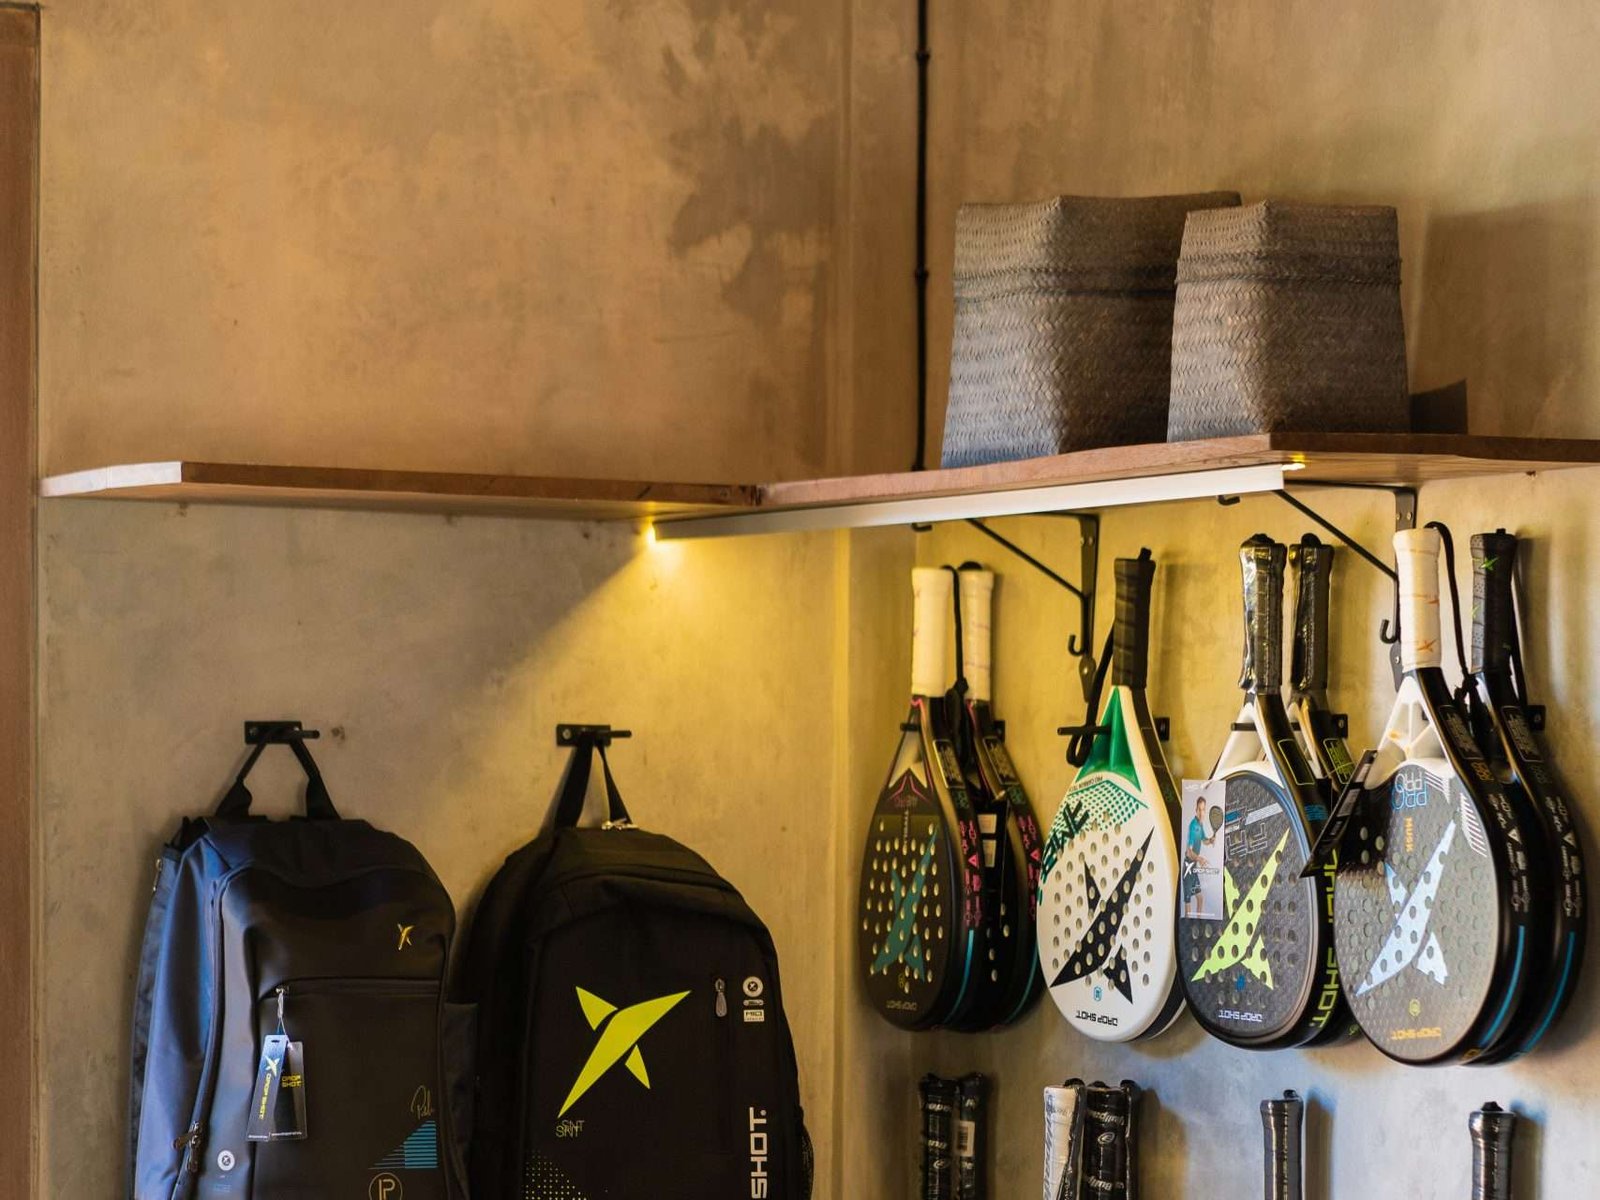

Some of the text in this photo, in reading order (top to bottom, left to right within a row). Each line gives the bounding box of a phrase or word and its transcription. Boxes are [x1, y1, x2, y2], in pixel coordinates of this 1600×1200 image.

[1391, 779, 1428, 810] PRO
[1075, 1010, 1118, 1027] DROP SHOT
[1218, 1009, 1263, 1022] DROP SHOT
